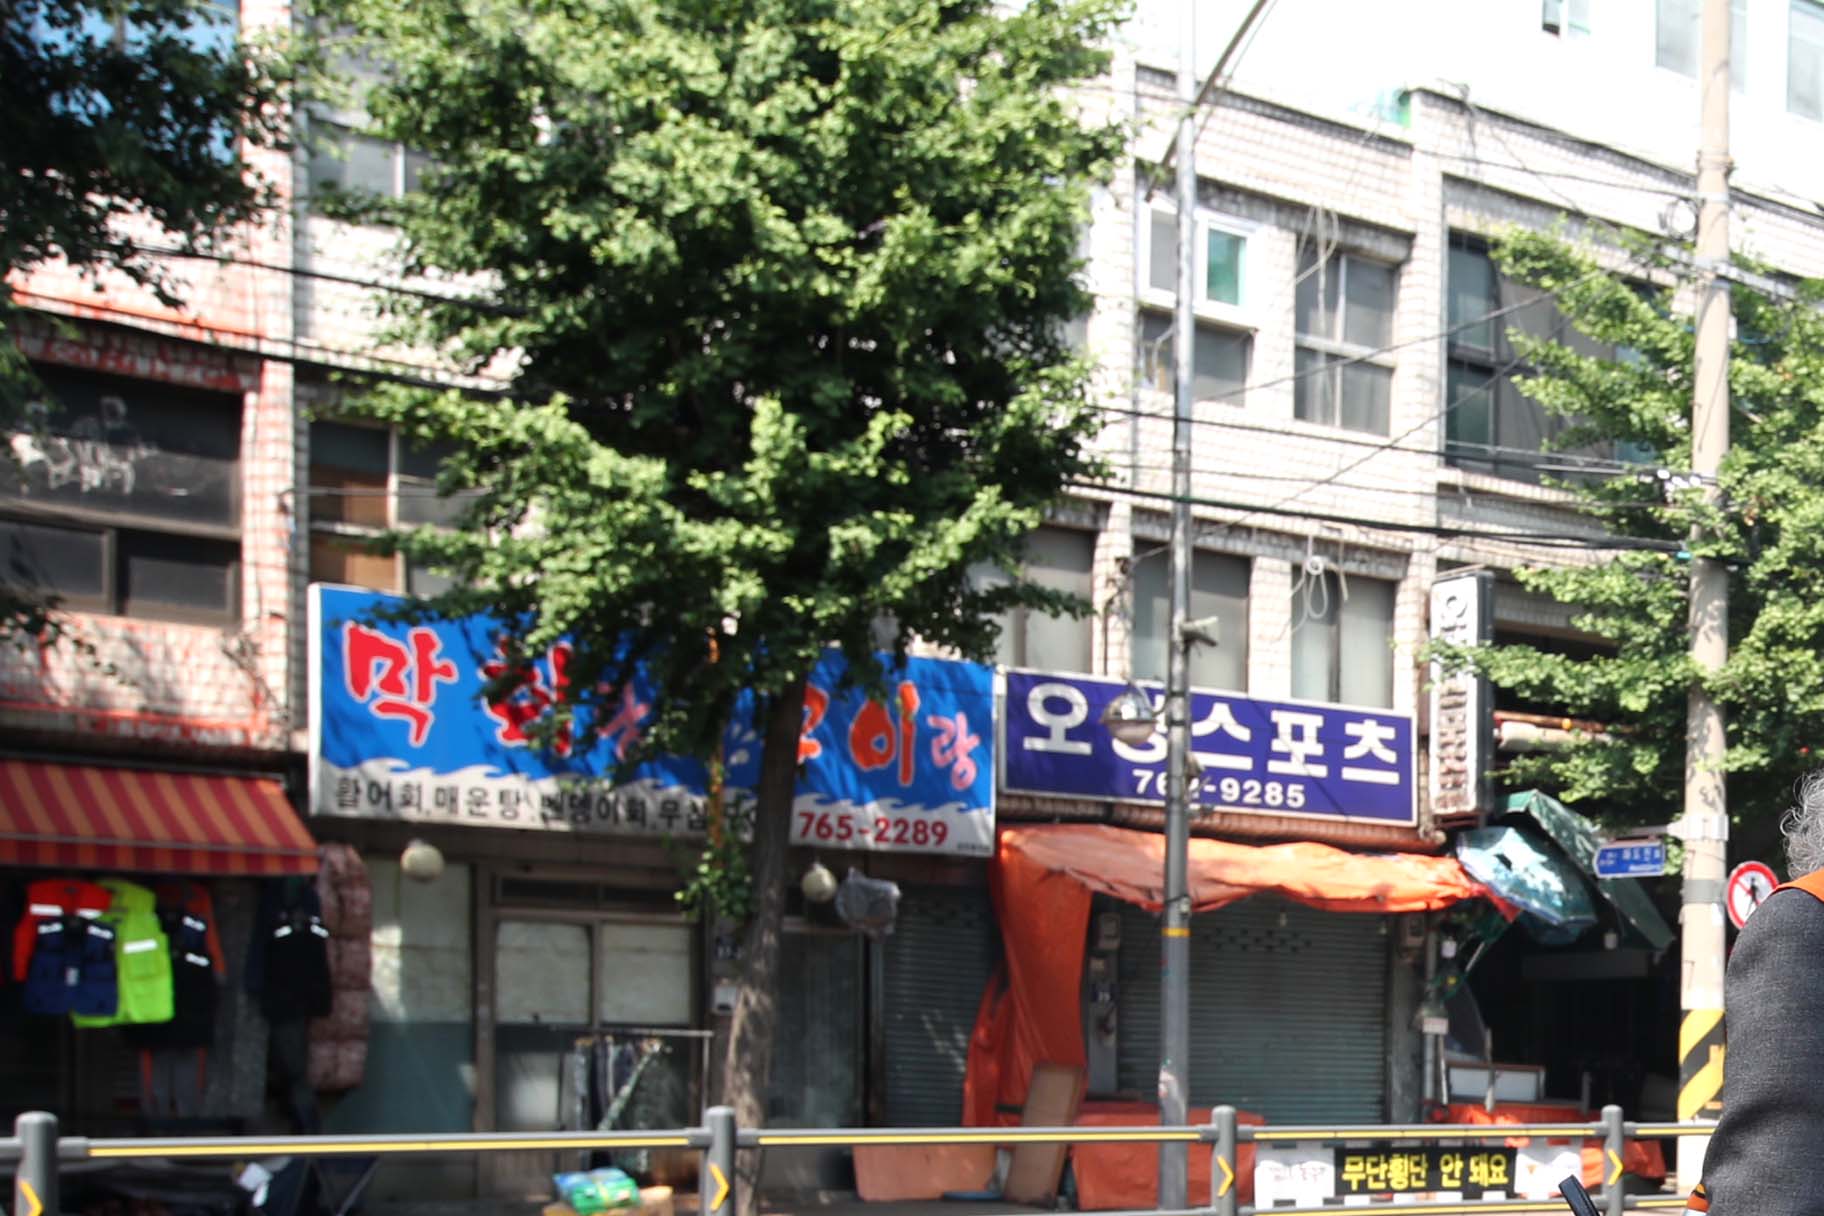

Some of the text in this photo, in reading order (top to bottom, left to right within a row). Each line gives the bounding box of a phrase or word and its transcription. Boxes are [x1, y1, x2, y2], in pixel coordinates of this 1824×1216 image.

[799, 811, 949, 846] 765-2289
[1342, 1153, 1428, 1191] 무단횡단
[1439, 1153, 1464, 1188] 안
[1468, 1153, 1509, 1187] 돼요
